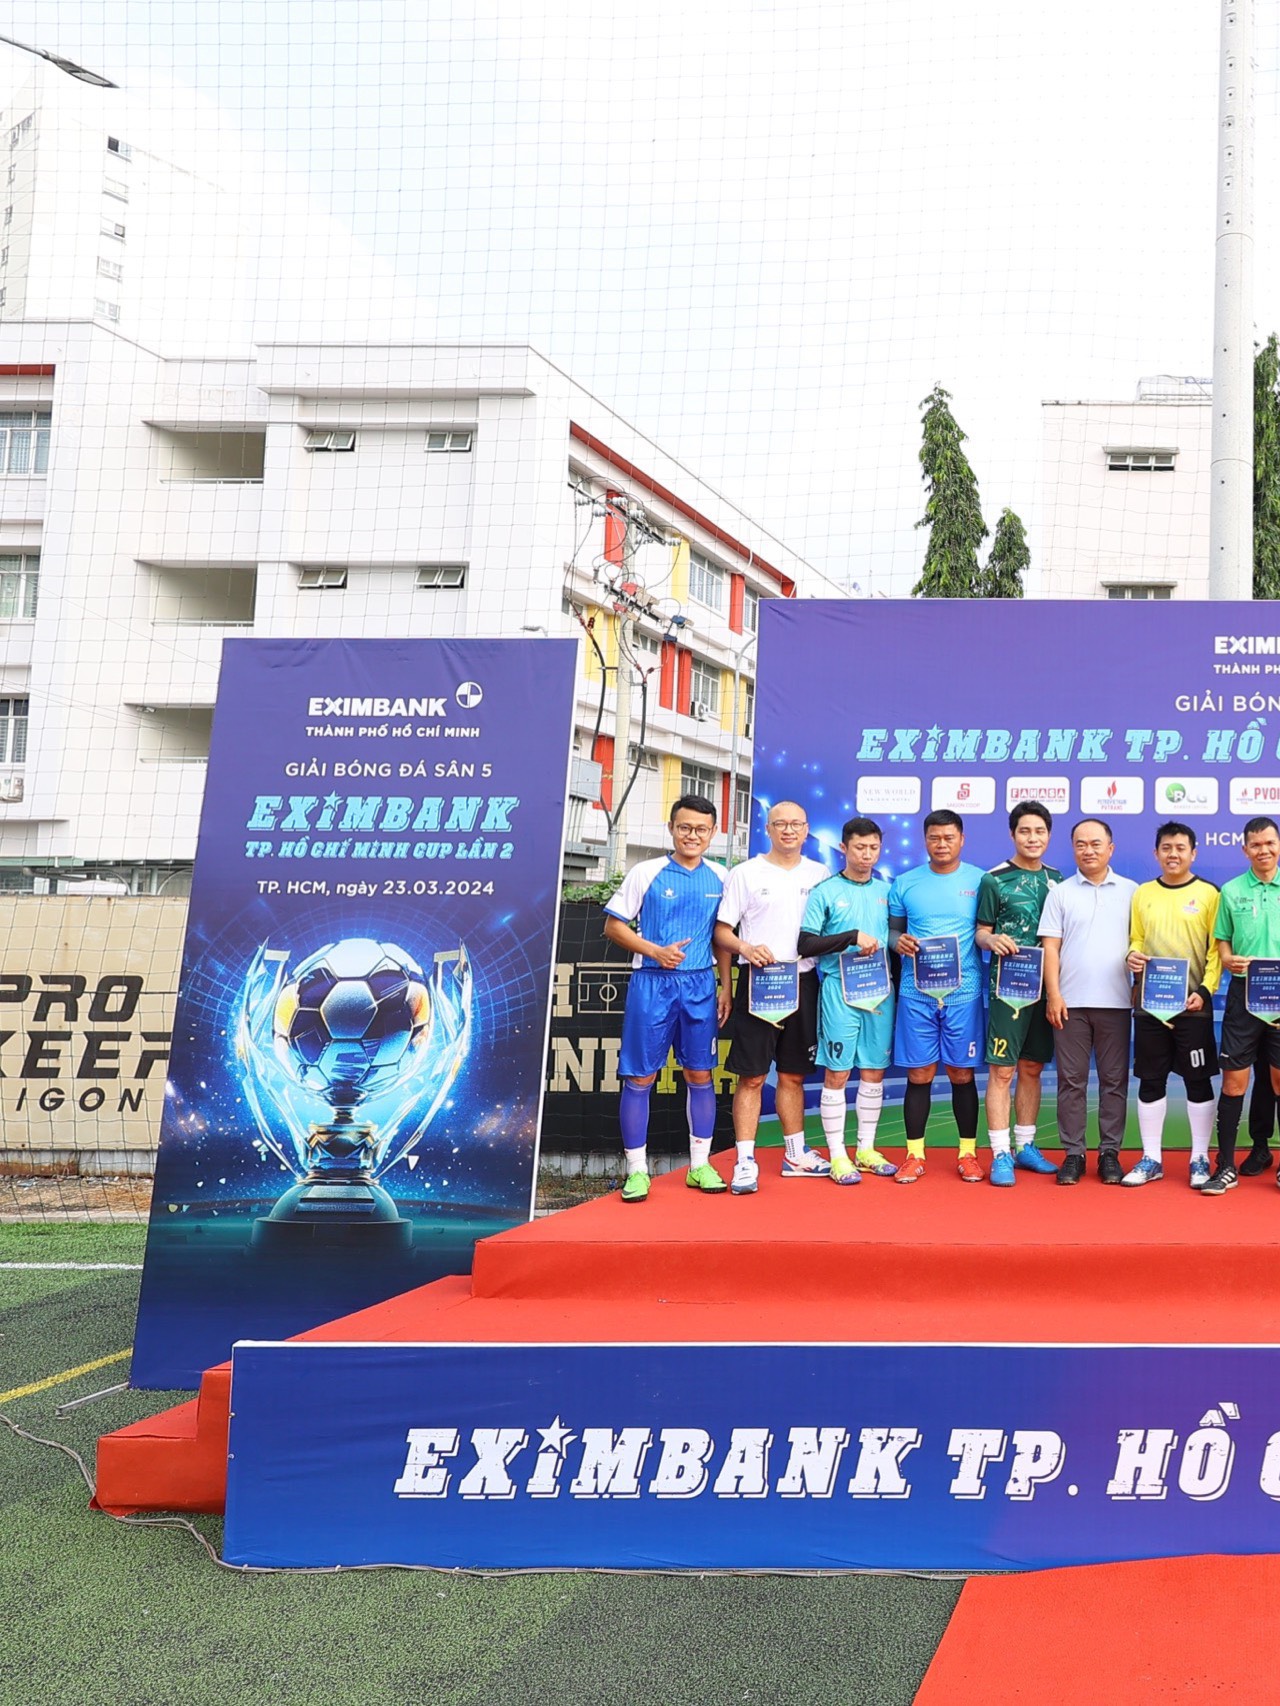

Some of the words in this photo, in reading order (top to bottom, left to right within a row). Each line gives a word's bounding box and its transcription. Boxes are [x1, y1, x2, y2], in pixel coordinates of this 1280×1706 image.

[1214, 663, 1260, 674] THÀNH
[309, 697, 447, 716] EXIMBANK
[1176, 690, 1222, 711] GIẢI
[305, 724, 354, 737] THÀNH
[357, 724, 388, 737] PHỐ
[392, 724, 412, 737] HỒ
[417, 725, 440, 737] CHÍ
[445, 728, 479, 737] MINH
[1125, 730, 1188, 762] TP.
[1202, 718, 1266, 763] HỒ
[286, 758, 326, 776] GIẢI
[334, 759, 391, 776] BÓNG
[399, 760, 426, 776] ĐÁ
[435, 760, 474, 777] SÂN
[482, 764, 491, 777] 5
[1011, 788, 1066, 799] FAHASA
[246, 841, 273, 857] TP.
[278, 836, 312, 858] HỒ
[413, 843, 453, 858] CUP
[455, 837, 498, 858] LẦN
[500, 843, 514, 858] 2
[257, 881, 280, 893] TP.
[287, 881, 330, 896] HCM,
[337, 881, 377, 896] ngày
[383, 881, 494, 894] 23.03.2024
[828, 1041, 844, 1059] 19
[968, 1041, 976, 1058] 5
[993, 1038, 1008, 1058] 12
[1190, 1048, 1206, 1068] 01
[947, 1429, 1078, 1500] TP.
[1106, 1403, 1240, 1500] HỒ
